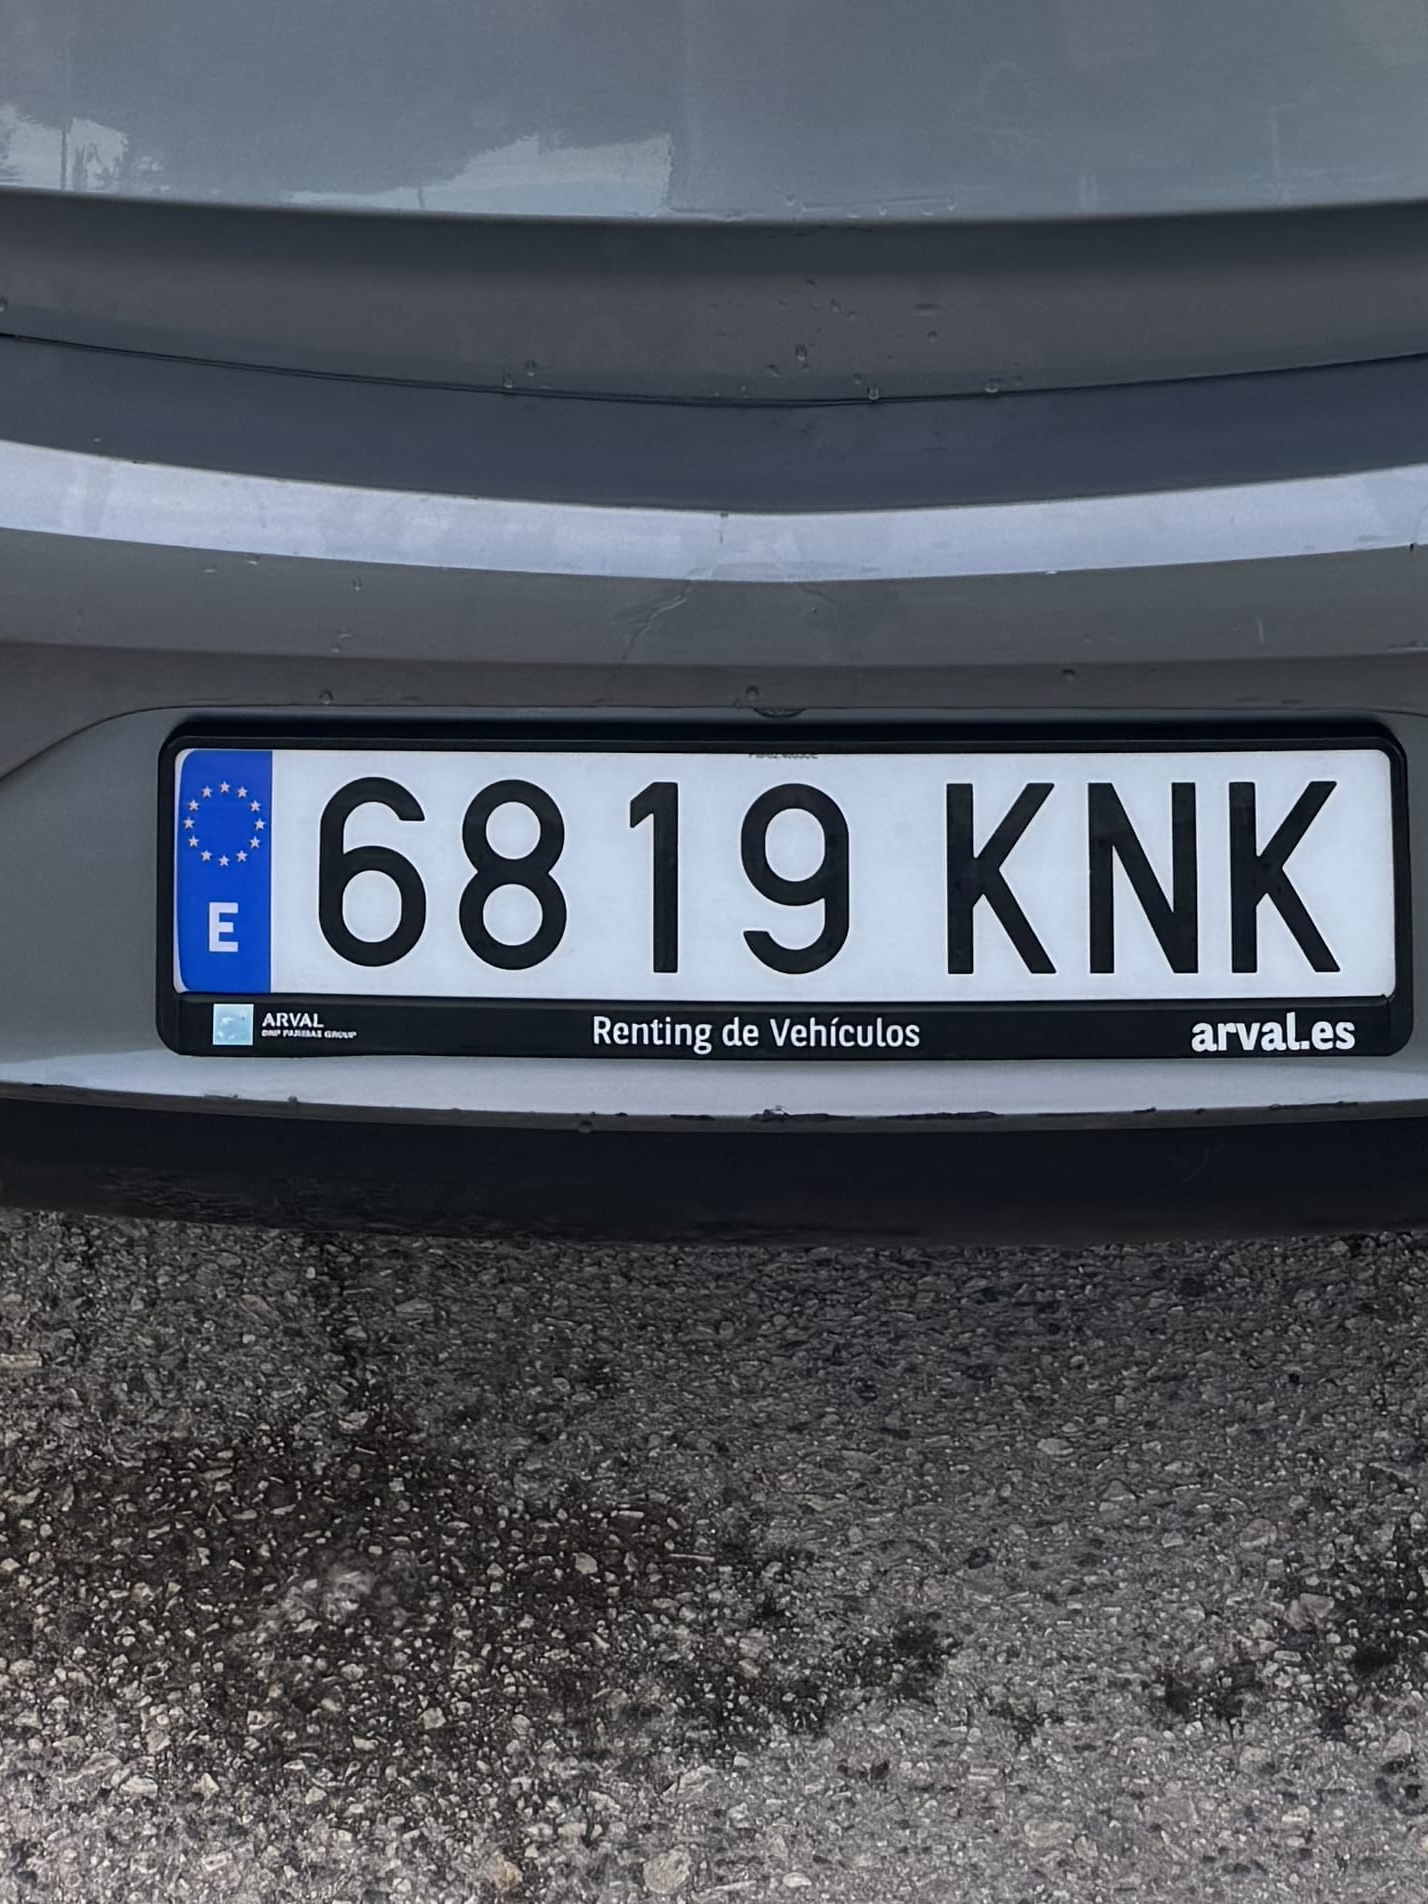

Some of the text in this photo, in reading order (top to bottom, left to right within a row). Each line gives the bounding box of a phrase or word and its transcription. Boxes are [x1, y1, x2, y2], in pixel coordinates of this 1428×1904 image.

[317, 775, 1341, 976] 6819 KNK
[207, 901, 240, 954] E
[262, 1012, 324, 1028] ARVAL
[593, 1015, 921, 1055] Renting de Vehículos
[1191, 1011, 1356, 1052] arval.es
